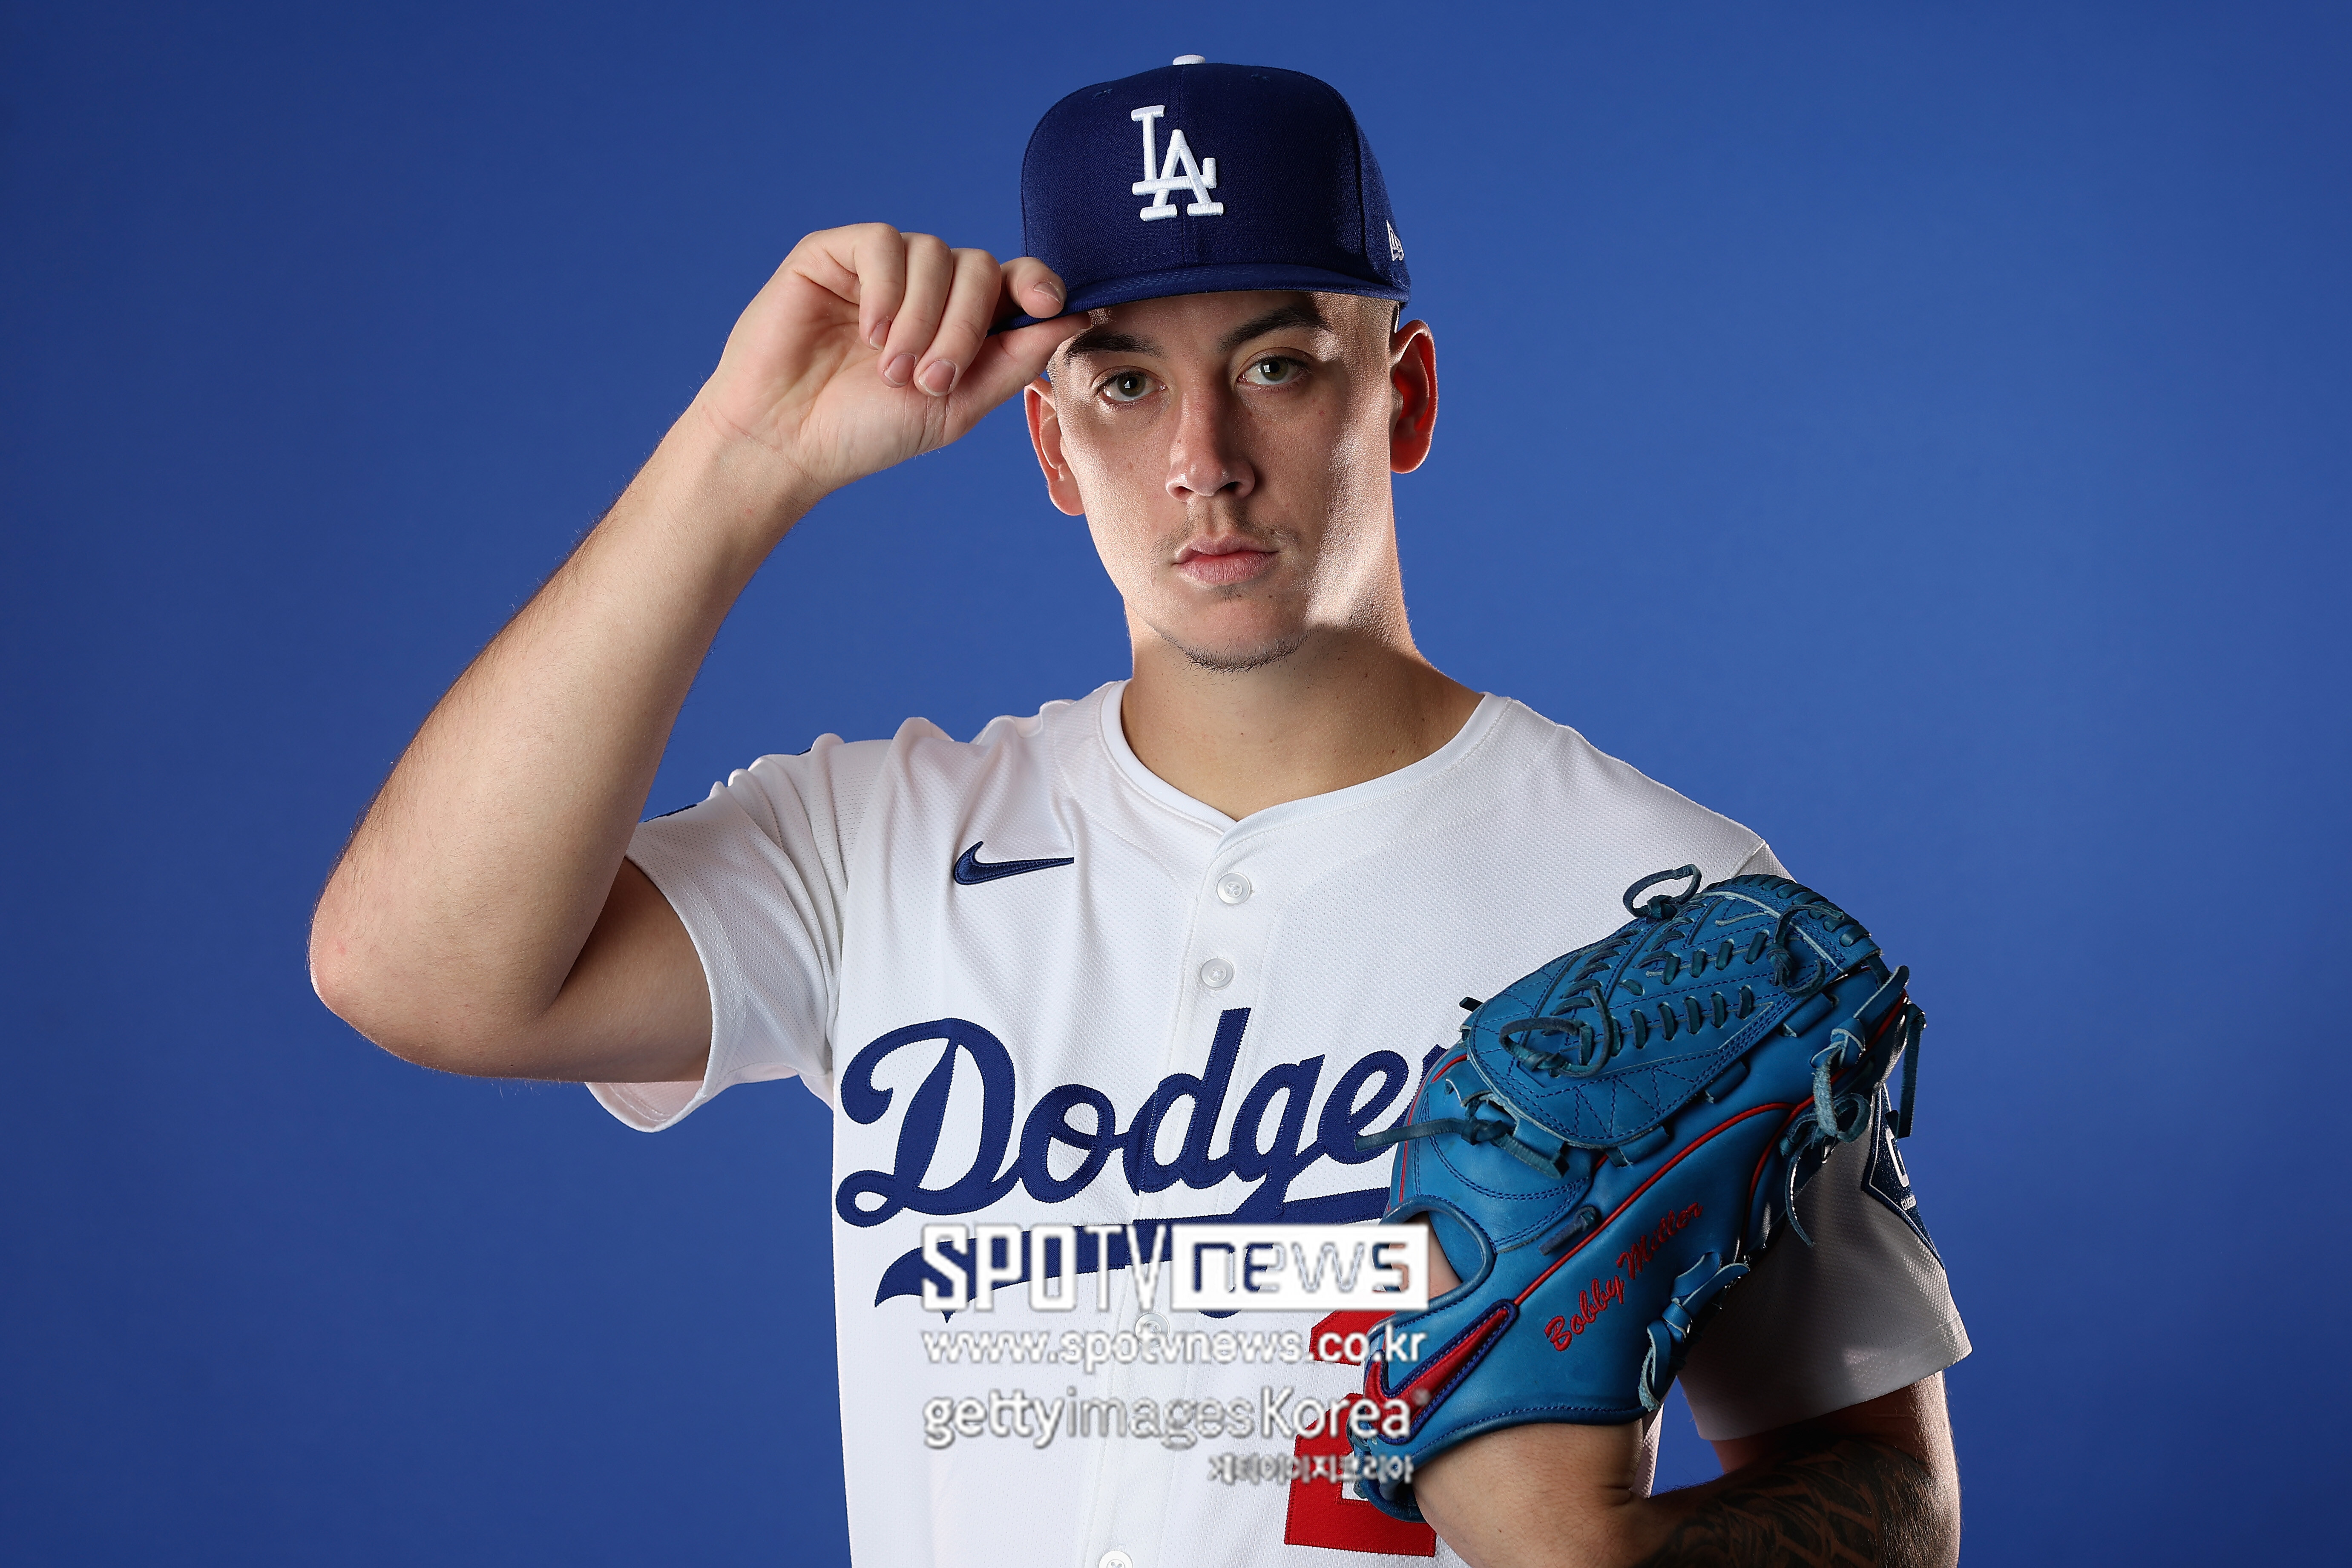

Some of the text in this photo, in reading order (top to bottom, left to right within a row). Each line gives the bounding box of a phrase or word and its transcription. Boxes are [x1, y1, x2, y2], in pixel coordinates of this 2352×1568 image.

[1131, 105, 1224, 222] LA
[836, 1007, 1449, 1228] Dodge
[1544, 1202, 1703, 1352] Bobby Miller
